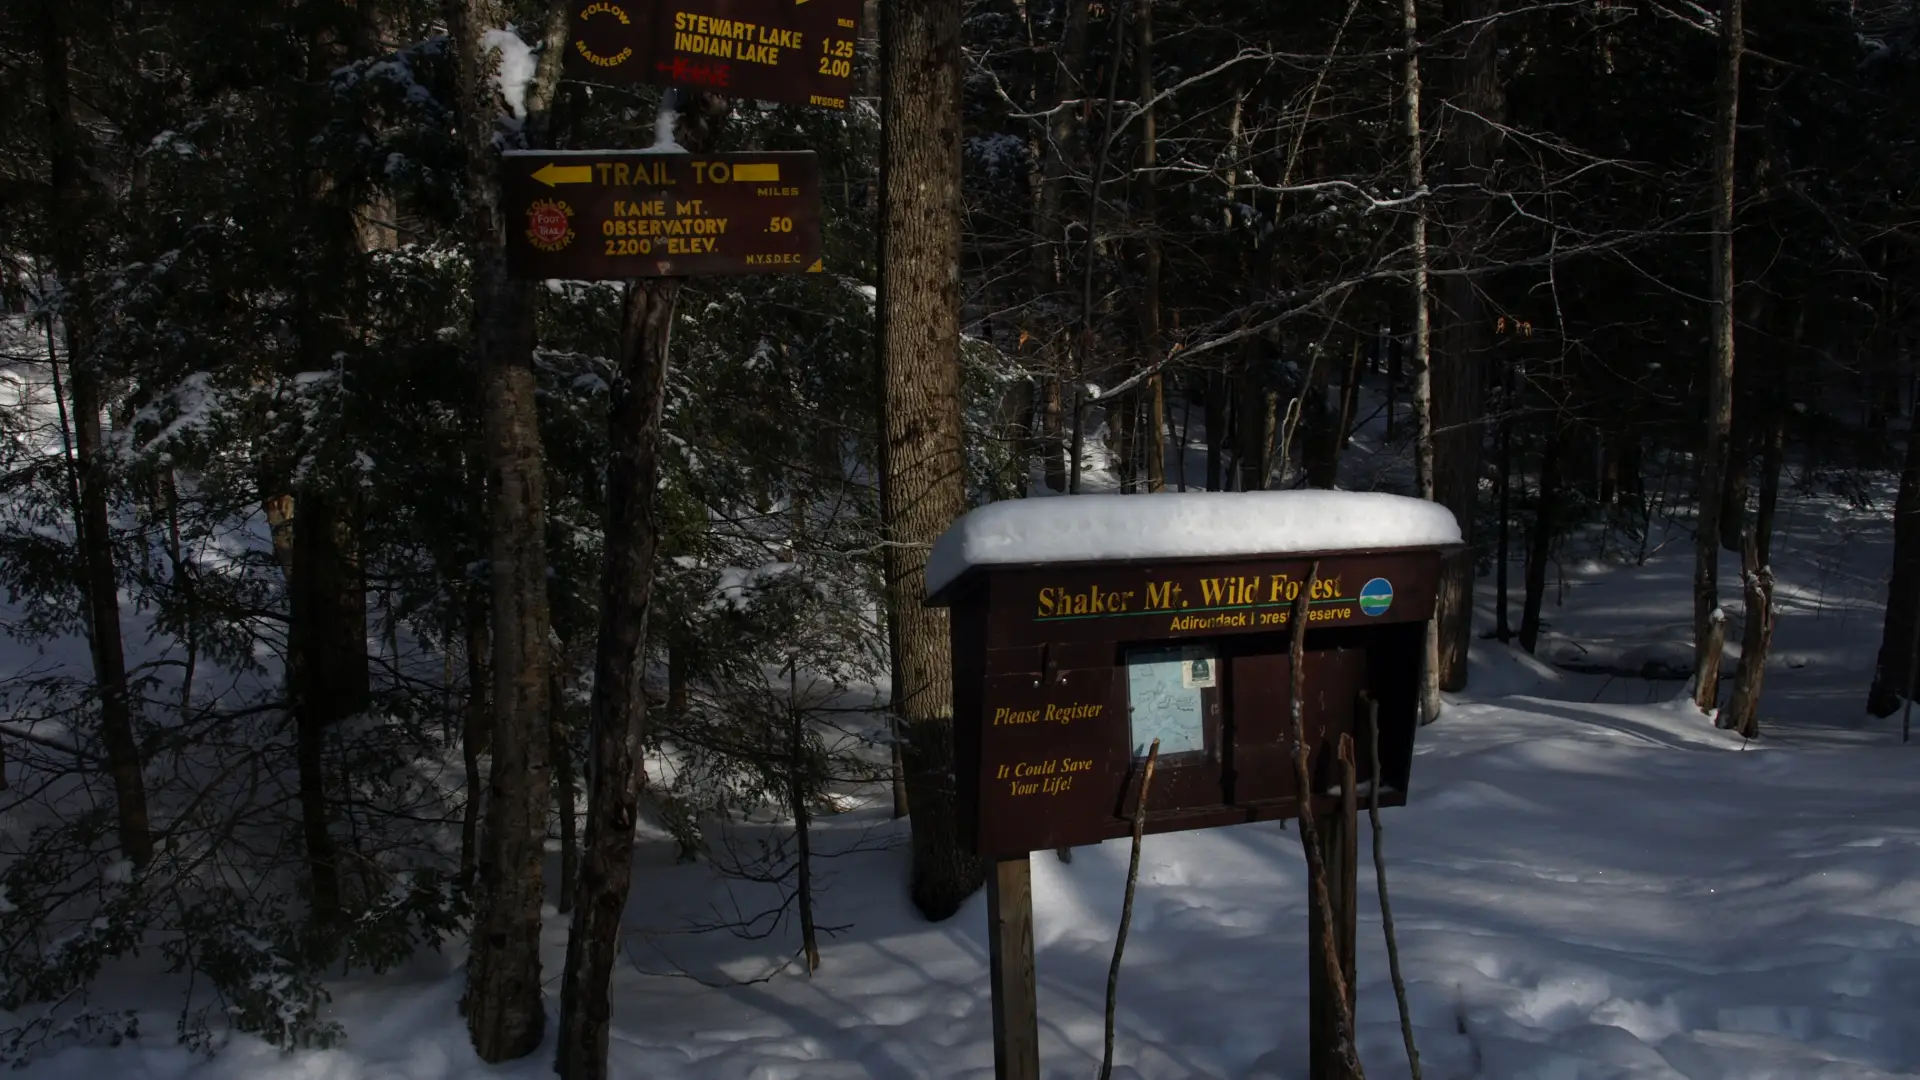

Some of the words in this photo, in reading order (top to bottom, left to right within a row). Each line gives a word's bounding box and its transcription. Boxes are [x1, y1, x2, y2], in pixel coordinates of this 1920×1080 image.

[580, 2, 631, 25] FOLLOW
[674, 11, 756, 41] STEWART
[759, 26, 803, 49] LAKE
[576, 40, 632, 67] MARKERS
[674, 32, 732, 59] INDIAN
[736, 41, 780, 65] LAKE
[822, 37, 854, 58] 1.25
[819, 56, 850, 78] 2.00
[810, 95, 845, 109] NYSDEC
[595, 161, 677, 186] TRAIL
[691, 160, 730, 184] TO
[757, 187, 800, 197] MILES
[525, 197, 575, 217] FOLLOW
[613, 199, 666, 217] KANE
[675, 199, 708, 217] MT.
[602, 217, 728, 237] OBSERVATORY
[763, 215, 793, 233] .50
[525, 228, 576, 252] MARKERS
[604, 238, 652, 256] 2200
[667, 236, 719, 255] ELEV.
[1037, 583, 1136, 617] Shaker
[1144, 580, 1188, 611] Mt.
[1199, 576, 1260, 606] Wild
[1170, 611, 1246, 632] Adirondack
[993, 706, 1040, 726] Please
[1045, 702, 1103, 724] Register
[997, 764, 1010, 779] It
[1015, 758, 1056, 777] Could
[1060, 756, 1093, 773] Save
[1009, 779, 1039, 796] Your
[1042, 776, 1073, 793] Life!
